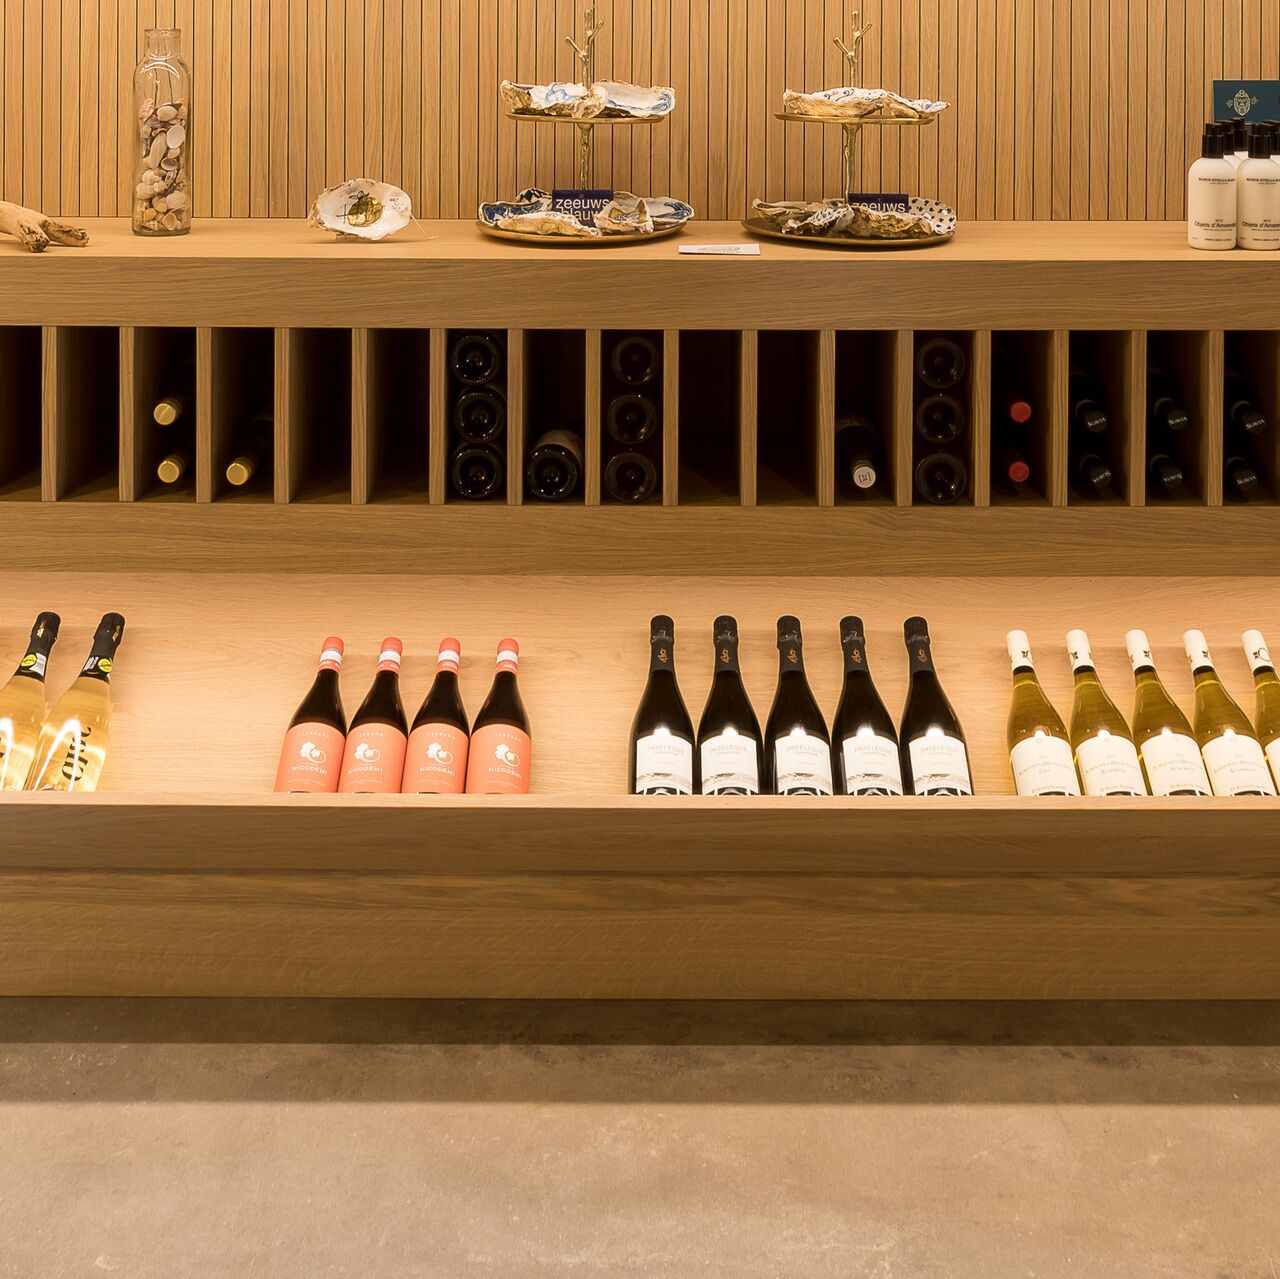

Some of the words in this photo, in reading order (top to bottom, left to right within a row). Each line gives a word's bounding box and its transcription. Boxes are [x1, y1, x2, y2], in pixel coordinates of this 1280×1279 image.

[555, 199, 610, 209] zeeuws
[291, 765, 328, 776] NICODEMI
[347, 765, 383, 775] NICODEMI
[419, 766, 455, 777] NICODEMI
[488, 767, 522, 780] NICODEMI
